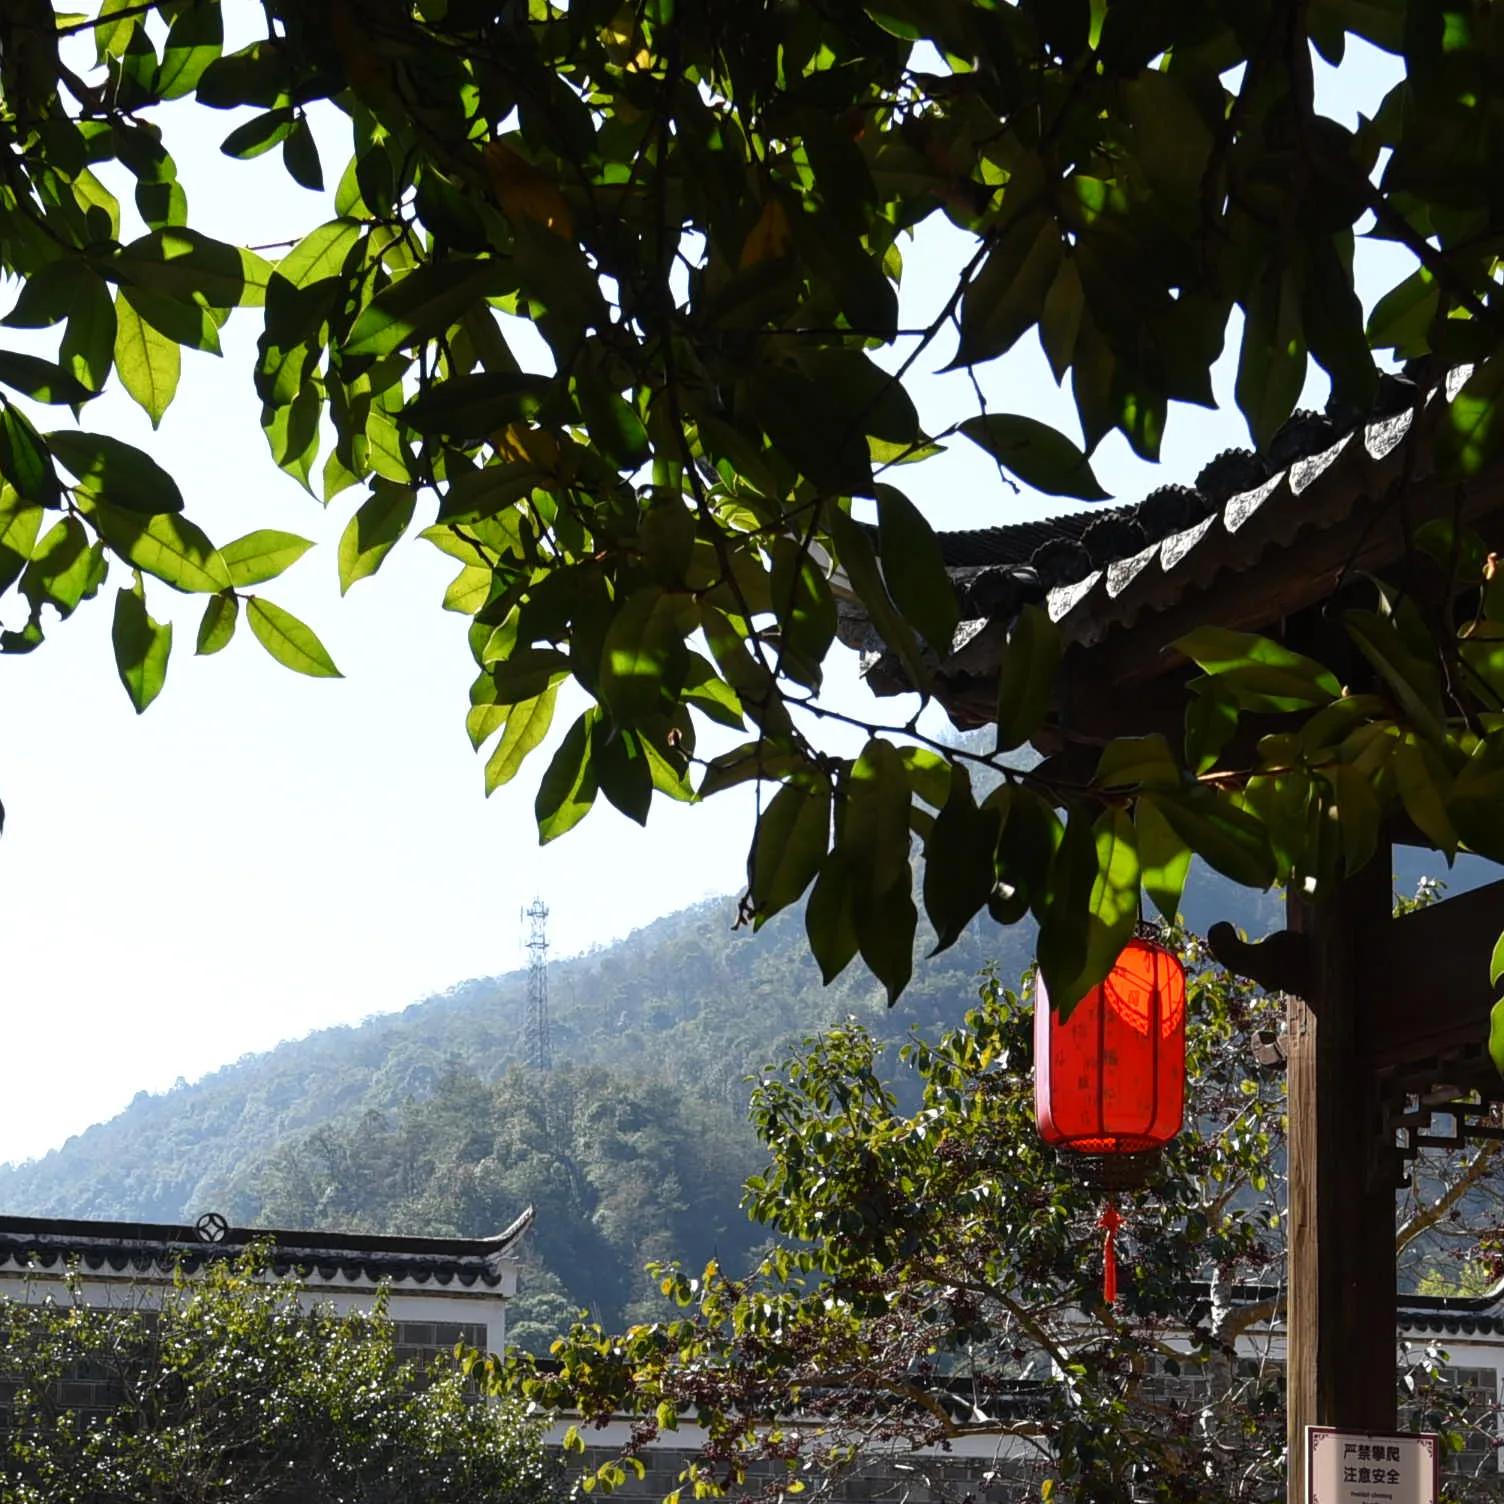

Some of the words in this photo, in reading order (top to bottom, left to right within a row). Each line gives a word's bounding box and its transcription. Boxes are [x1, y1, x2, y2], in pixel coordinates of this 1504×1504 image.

[1344, 1443, 1400, 1462] 严禁攀爬
[1344, 1467, 1400, 1484] 注意安全
